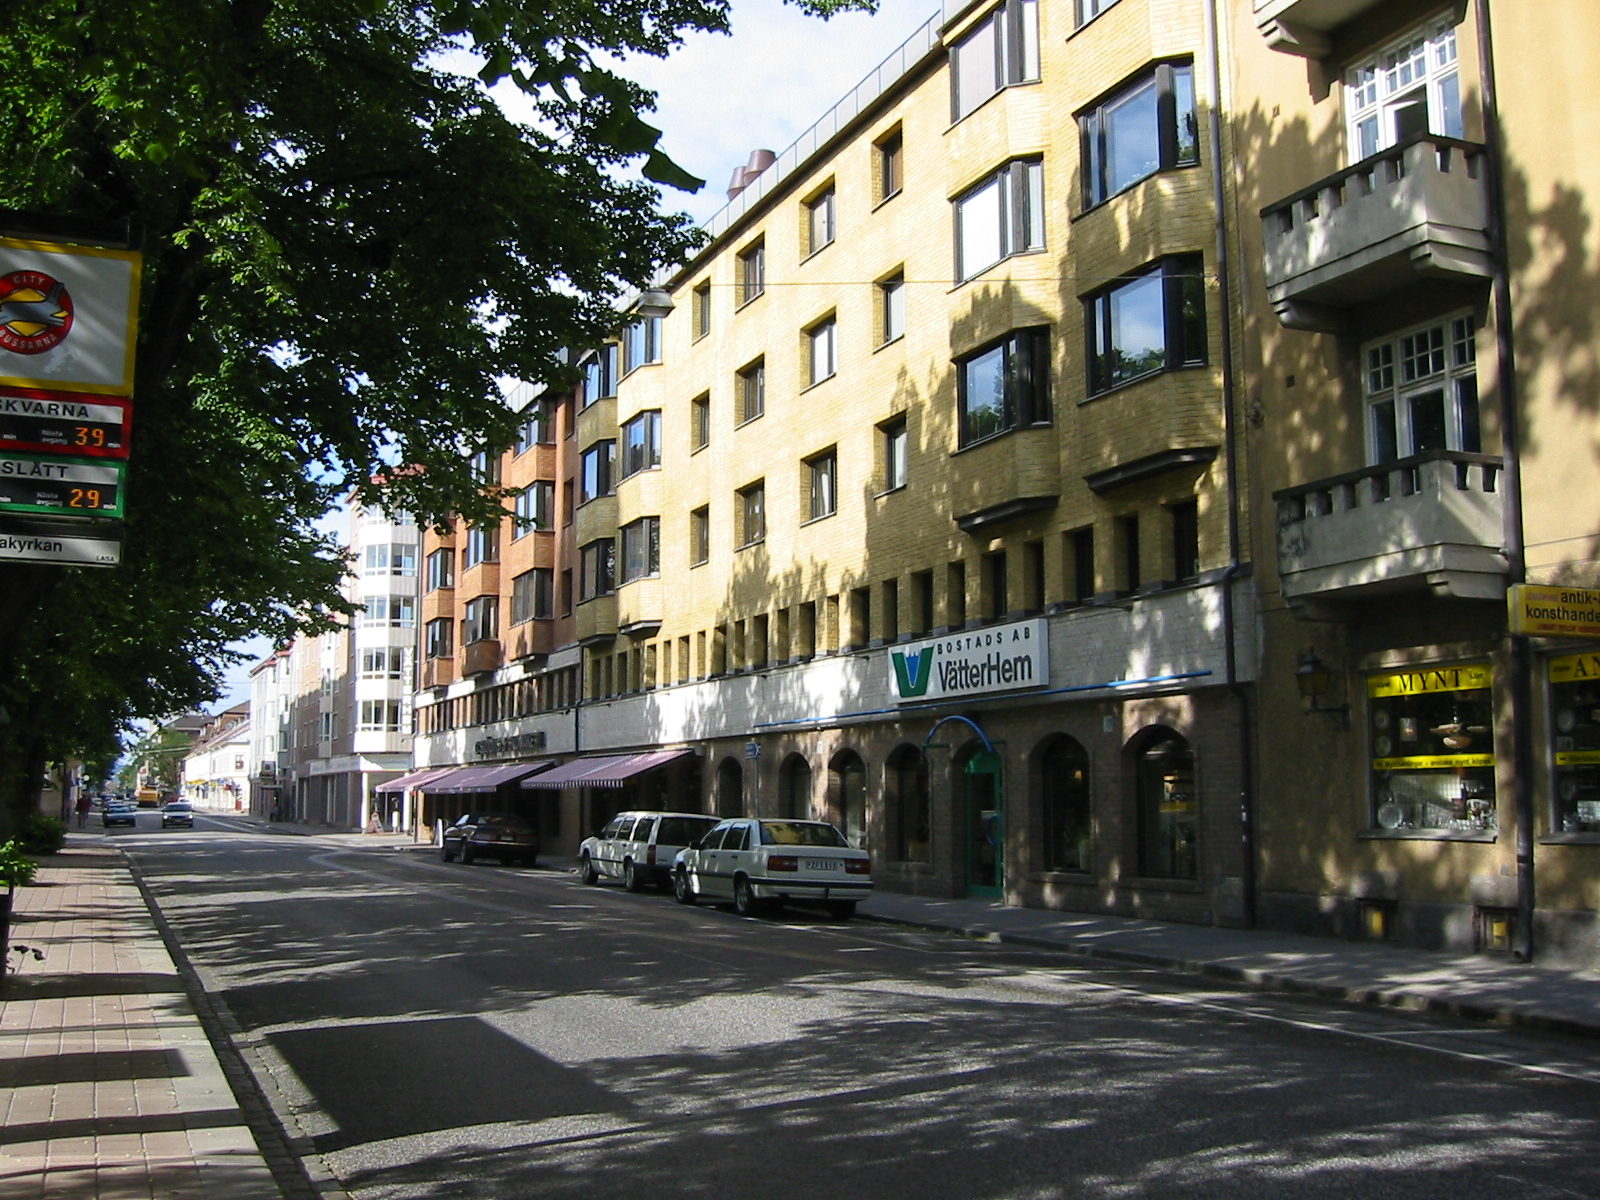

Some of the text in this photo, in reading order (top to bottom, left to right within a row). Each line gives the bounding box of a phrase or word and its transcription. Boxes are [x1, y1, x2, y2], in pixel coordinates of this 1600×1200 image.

[13, 275, 46, 285] CITY
[0, 329, 58, 349] BUSSARNA
[0, 399, 90, 418] KVARNA
[75, 427, 105, 447] 39
[70, 488, 100, 509] 29
[0, 536, 63, 553] akyrkan
[937, 626, 1031, 655] BOSTADS AB
[938, 652, 1032, 692] VätterHem
[1397, 668, 1463, 693] MYNT
